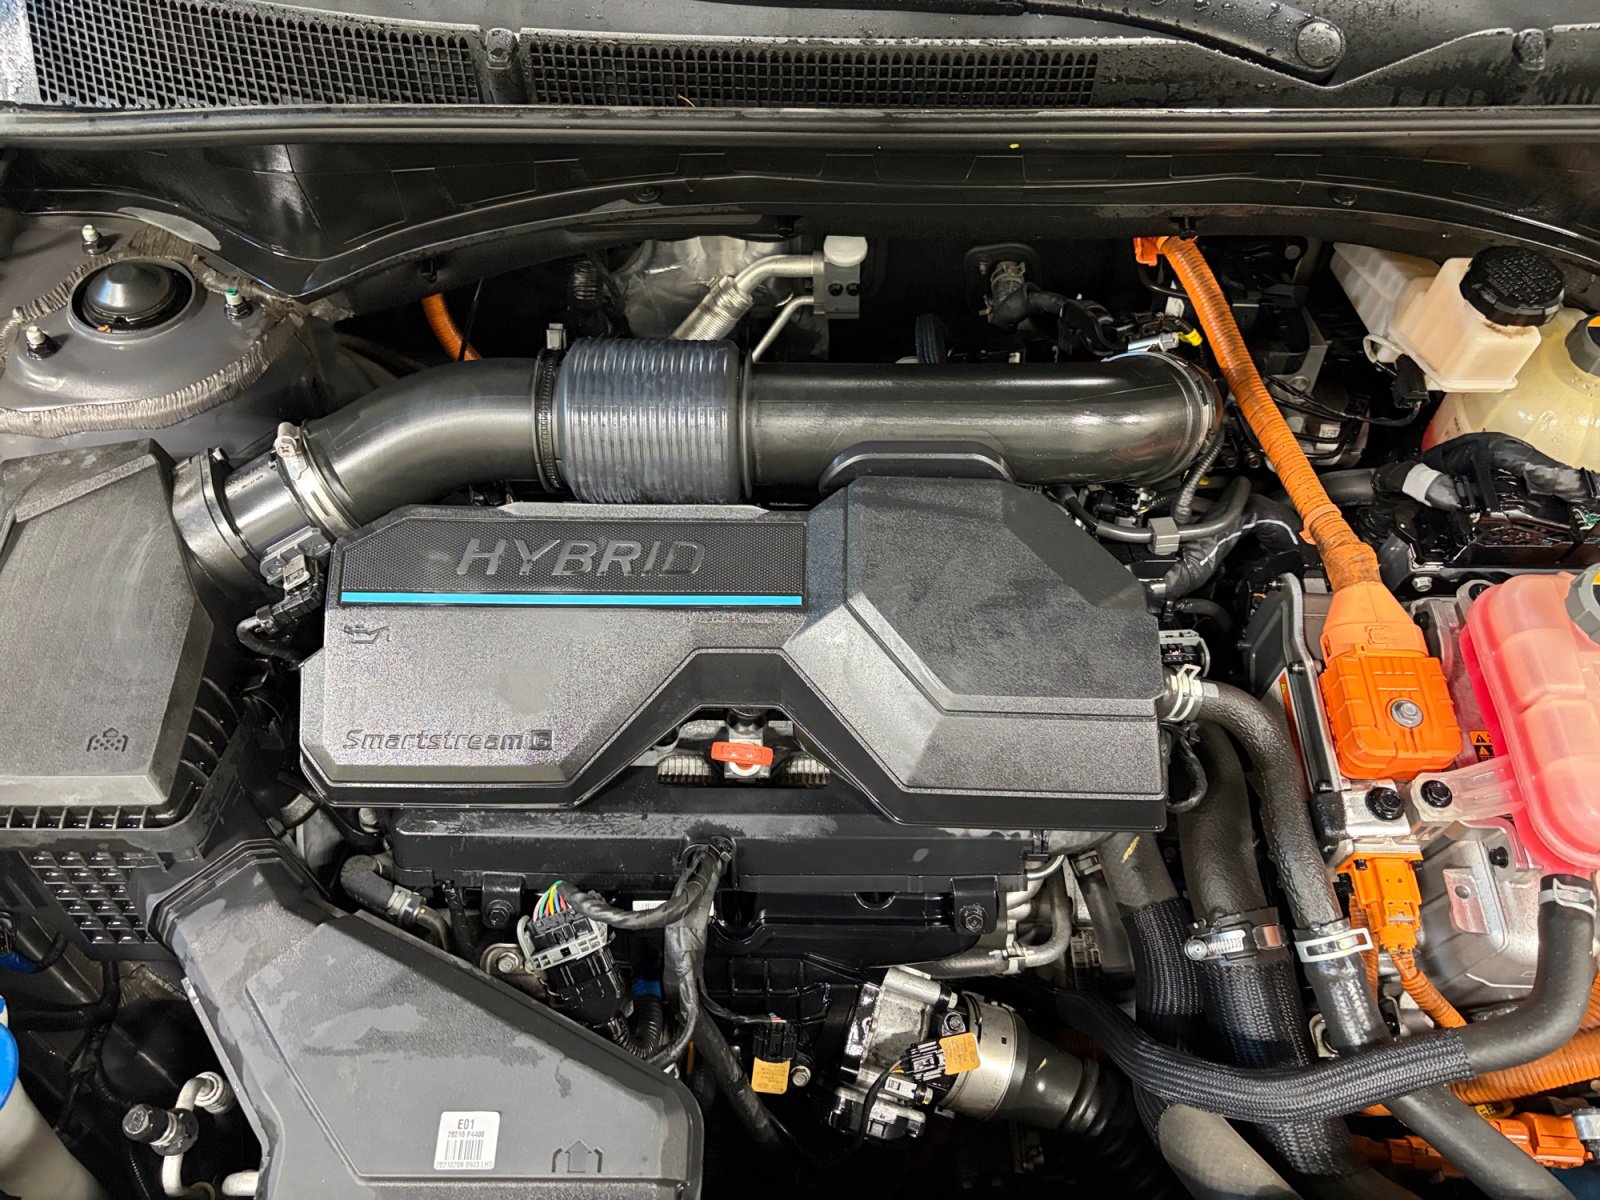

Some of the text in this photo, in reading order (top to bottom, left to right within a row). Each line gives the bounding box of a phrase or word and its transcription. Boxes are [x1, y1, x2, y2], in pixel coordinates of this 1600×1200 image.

[456, 538, 706, 576] HYBRID
[342, 729, 552, 750] Smartstream G
[457, 1118, 475, 1130] E01
